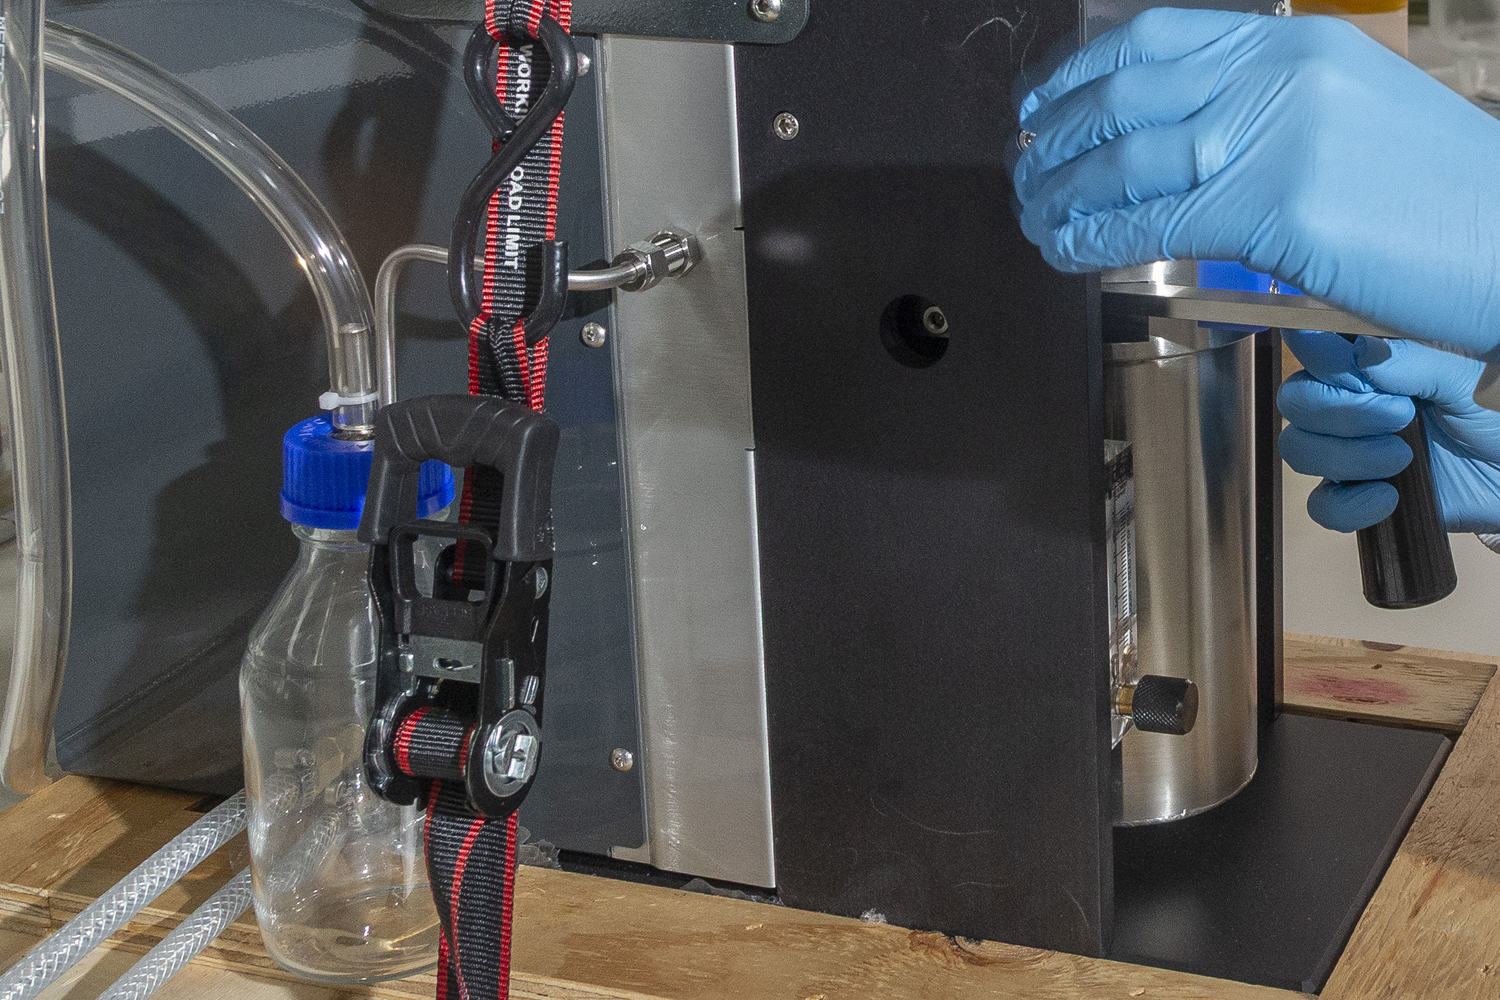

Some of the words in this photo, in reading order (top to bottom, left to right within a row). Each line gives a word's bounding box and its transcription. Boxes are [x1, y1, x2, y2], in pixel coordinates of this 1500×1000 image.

[514, 43, 534, 127] WORKIN
[508, 166, 524, 210] OAD
[504, 214, 521, 270] LIMIT
